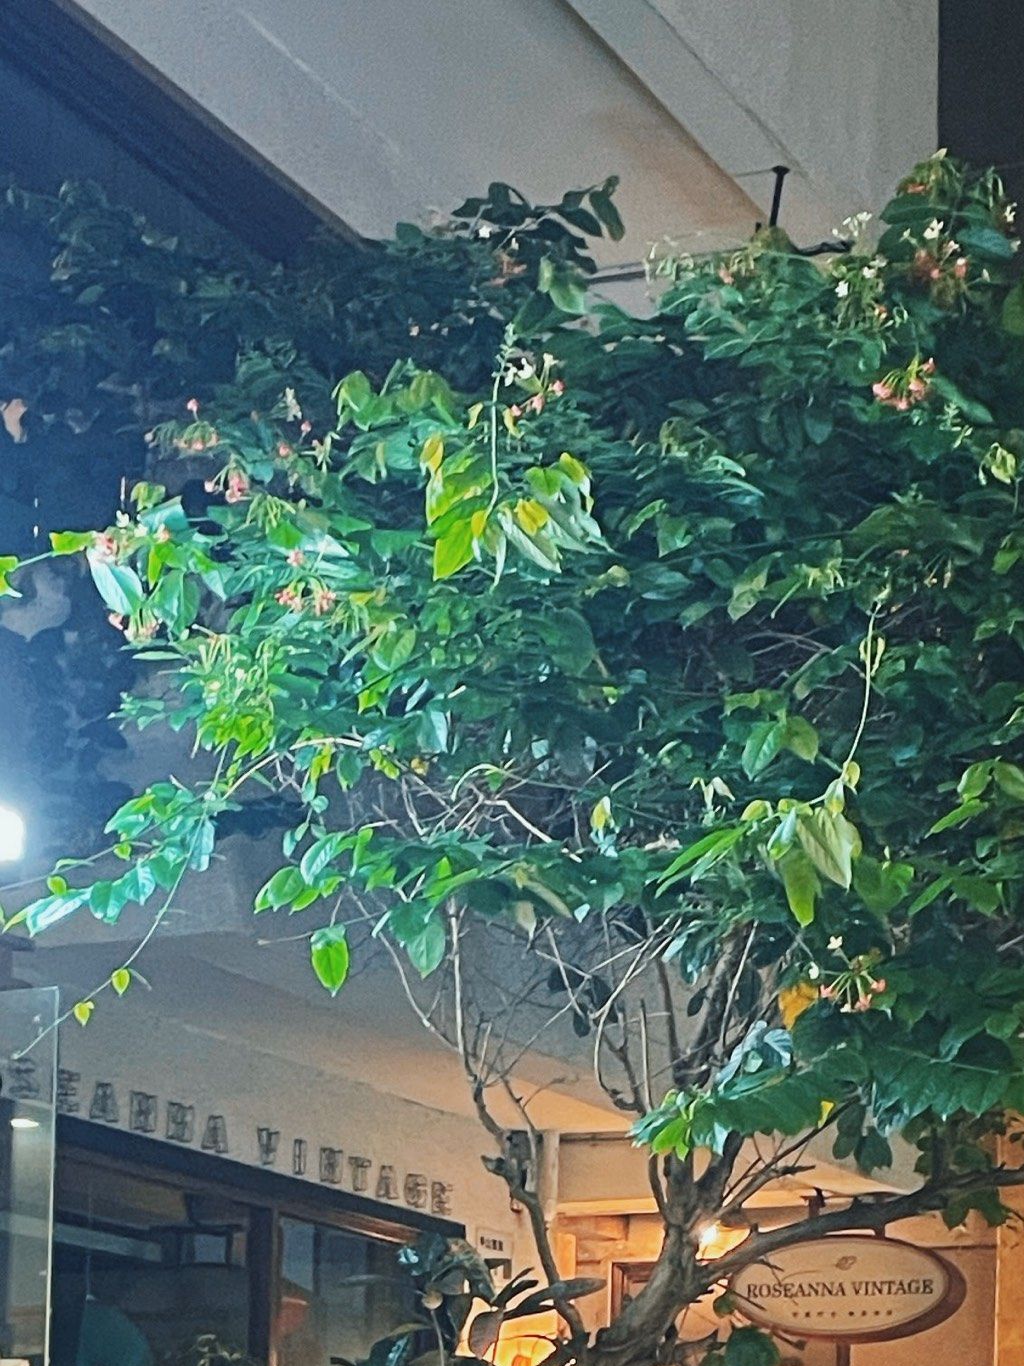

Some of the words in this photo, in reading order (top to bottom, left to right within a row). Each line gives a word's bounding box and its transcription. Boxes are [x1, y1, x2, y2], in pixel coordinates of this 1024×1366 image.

[257, 1127, 453, 1214] VINTAGE
[747, 1281, 846, 1300] ROSEANNA
[852, 1279, 934, 1297] VINTAGE
